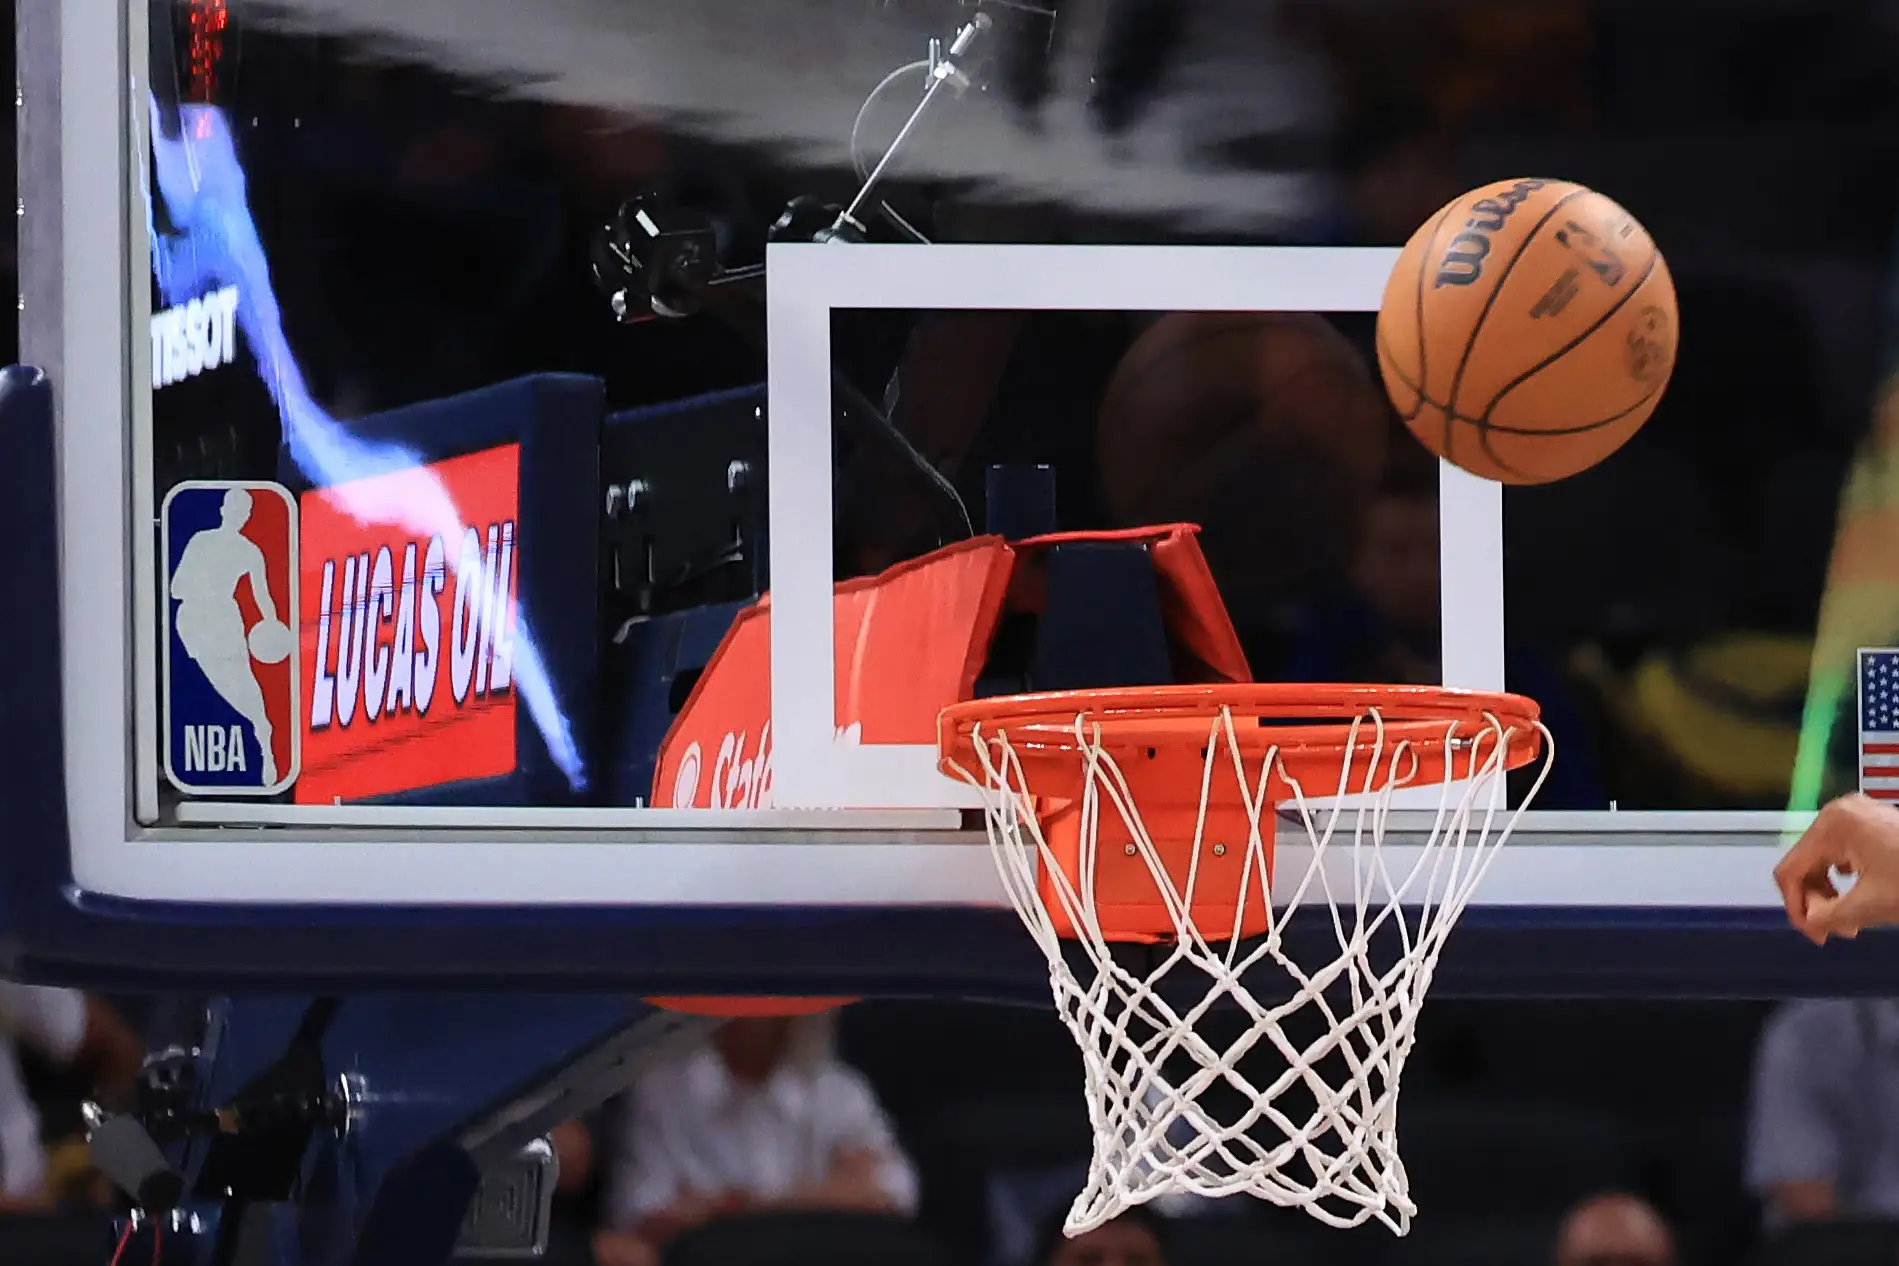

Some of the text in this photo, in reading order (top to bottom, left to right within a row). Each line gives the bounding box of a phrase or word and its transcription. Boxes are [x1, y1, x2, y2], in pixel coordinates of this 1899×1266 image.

[151, 284, 237, 390] TISSOT
[310, 519, 515, 734] LUCAS OIL
[183, 724, 247, 773] NBA
